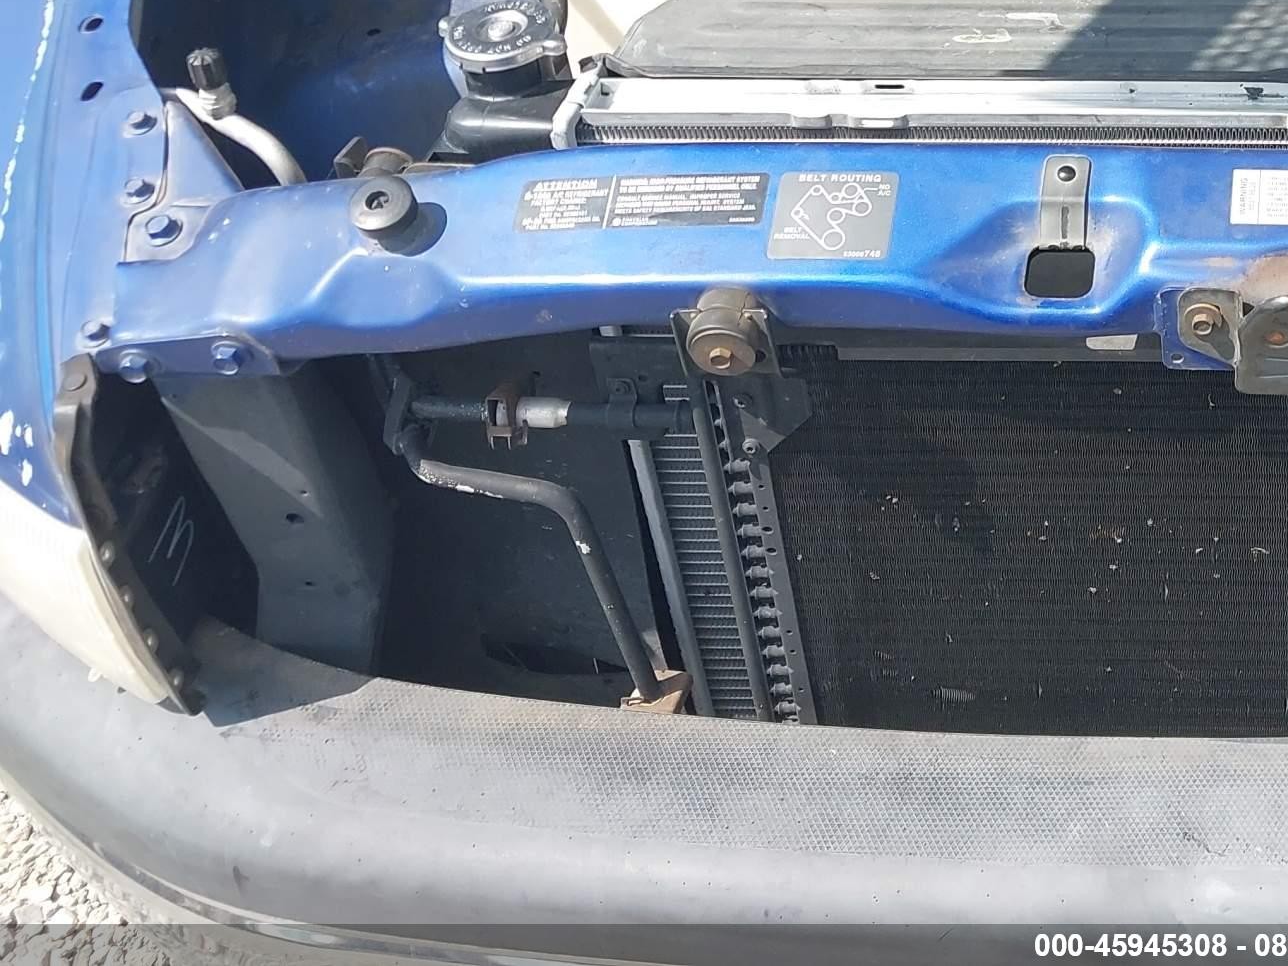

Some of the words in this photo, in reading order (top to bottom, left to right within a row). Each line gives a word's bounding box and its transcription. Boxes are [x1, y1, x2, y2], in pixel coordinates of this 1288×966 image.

[798, 174, 827, 183] BELT
[830, 174, 882, 183] ROUTING
[533, 178, 597, 192] ATTENTION
